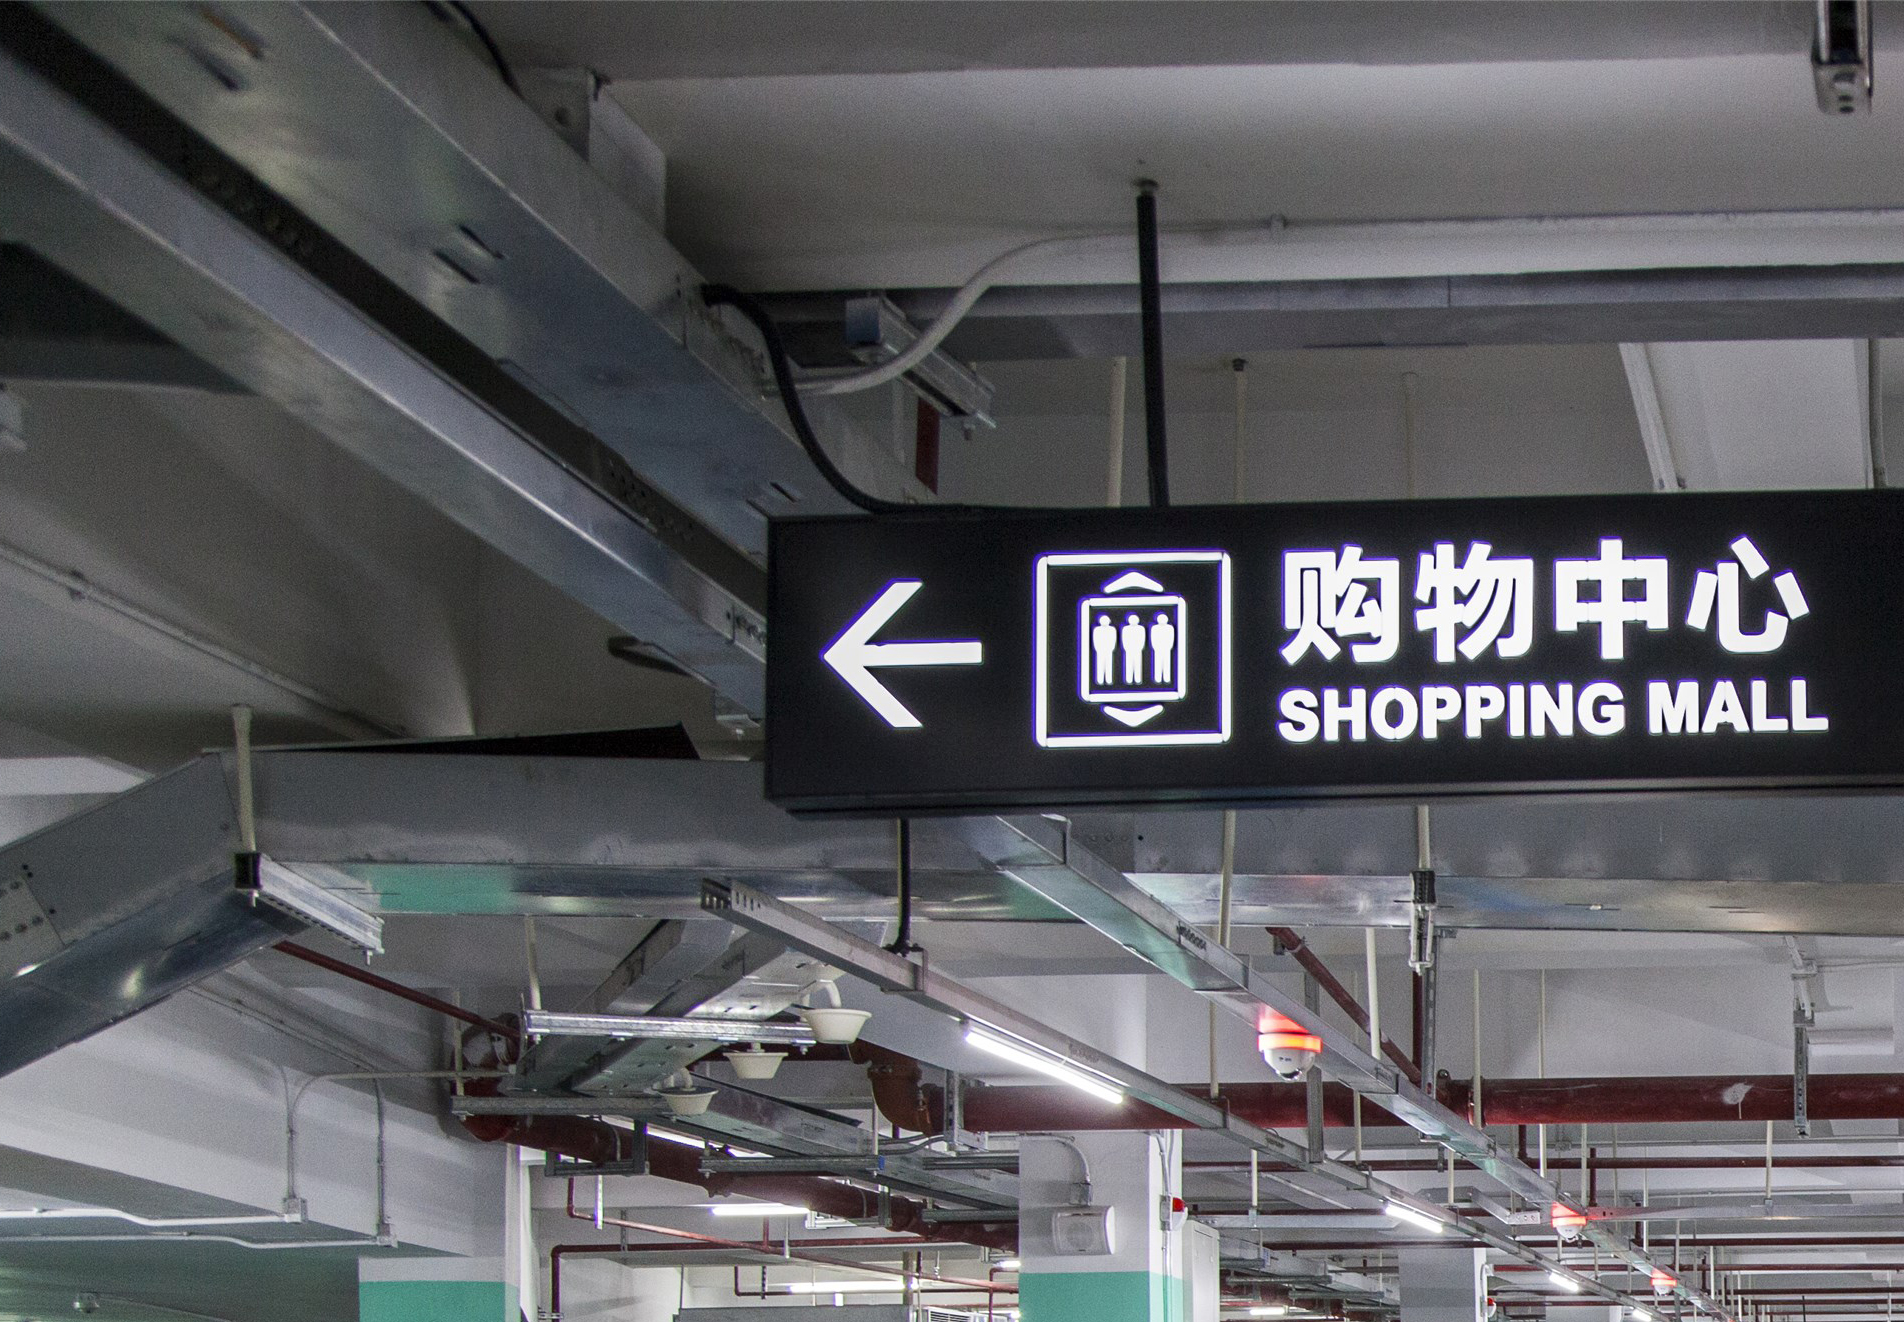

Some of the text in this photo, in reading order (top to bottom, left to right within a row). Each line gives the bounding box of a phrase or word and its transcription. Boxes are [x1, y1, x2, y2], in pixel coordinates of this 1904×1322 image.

[1279, 536, 1810, 665] 购物中心
[1277, 678, 1829, 742] SHOPPING MALL
